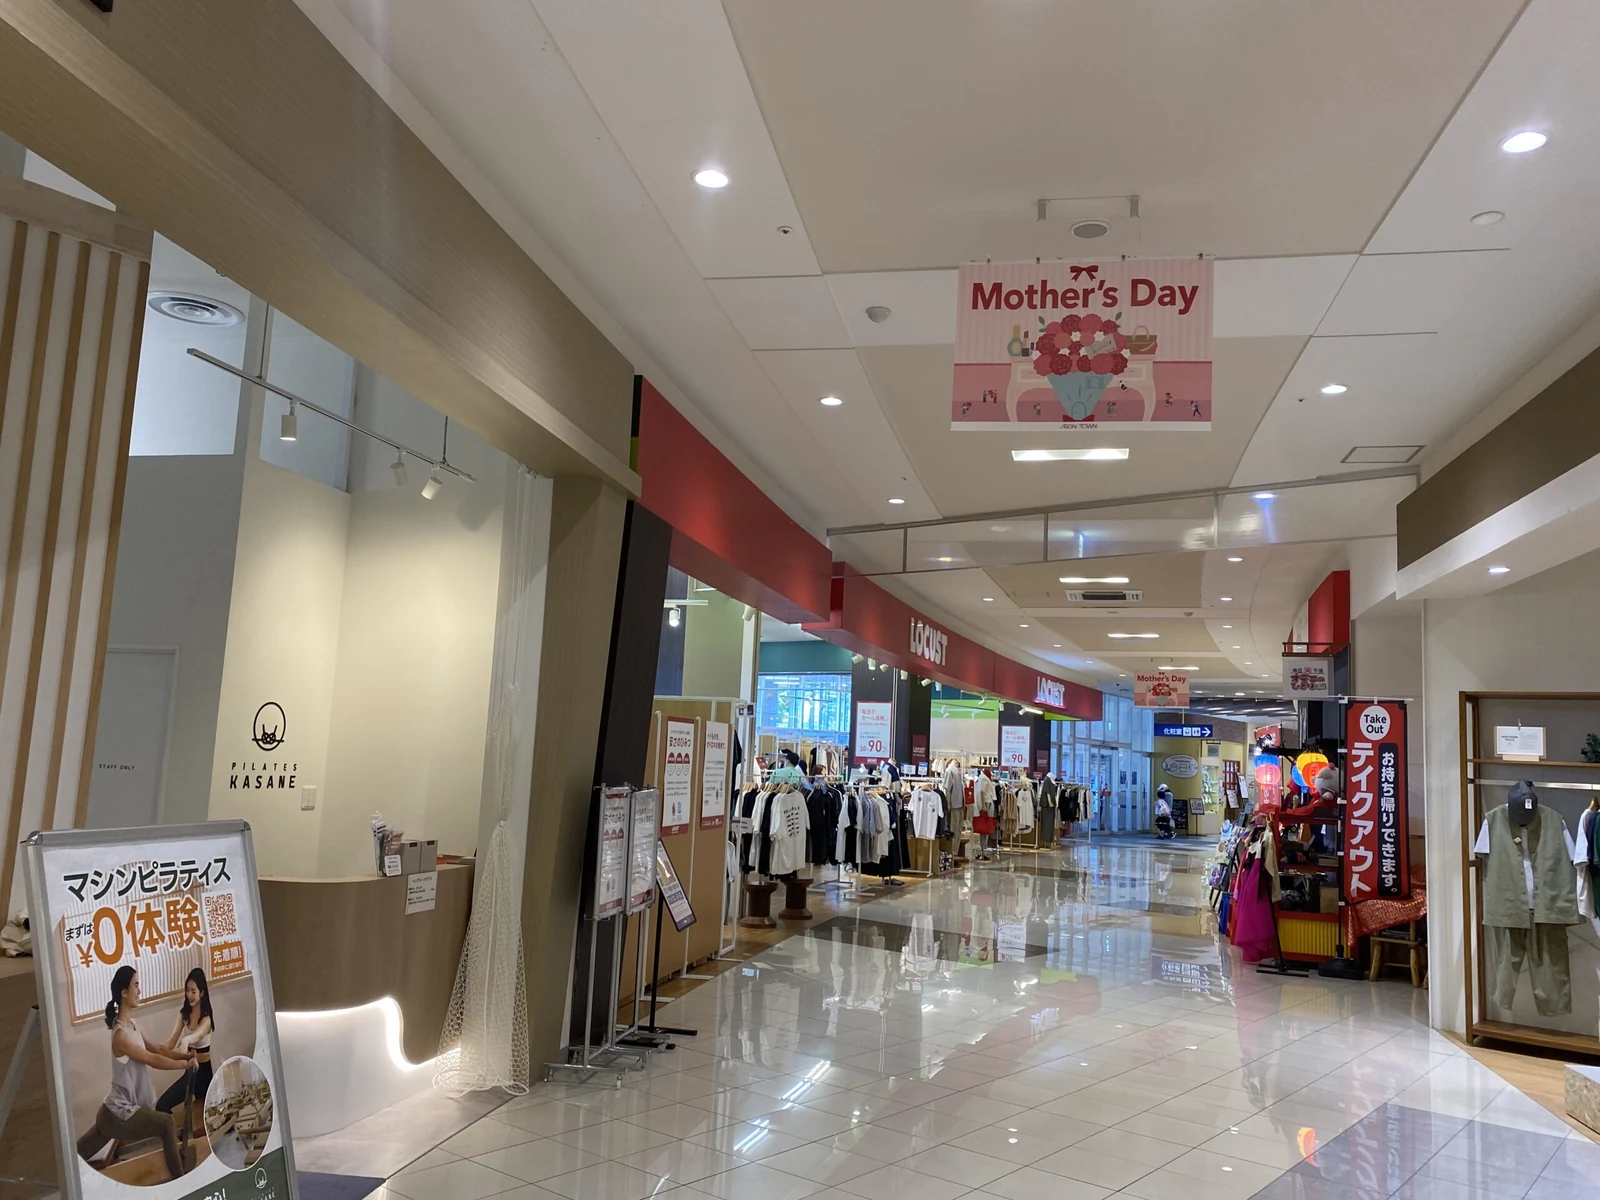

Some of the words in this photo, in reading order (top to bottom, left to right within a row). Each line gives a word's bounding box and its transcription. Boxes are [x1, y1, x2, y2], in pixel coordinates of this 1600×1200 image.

[971, 279, 1119, 310] Mother's
[1130, 278, 1199, 316] Day
[910, 617, 948, 666] LOCUST
[1137, 674, 1169, 682] Mother's
[1171, 674, 1187, 684] Day
[1363, 714, 1387, 724] Take
[1163, 727, 1183, 736] 化粧室
[1366, 724, 1384, 734] Out
[231, 762, 298, 771] PILATES
[229, 775, 297, 789] KASANE
[1350, 742, 1374, 898] テイクアウト
[1380, 751, 1398, 893] お持ち帰りできます。
[63, 856, 231, 903] マシンピラティス
[64, 922, 94, 942] まずは
